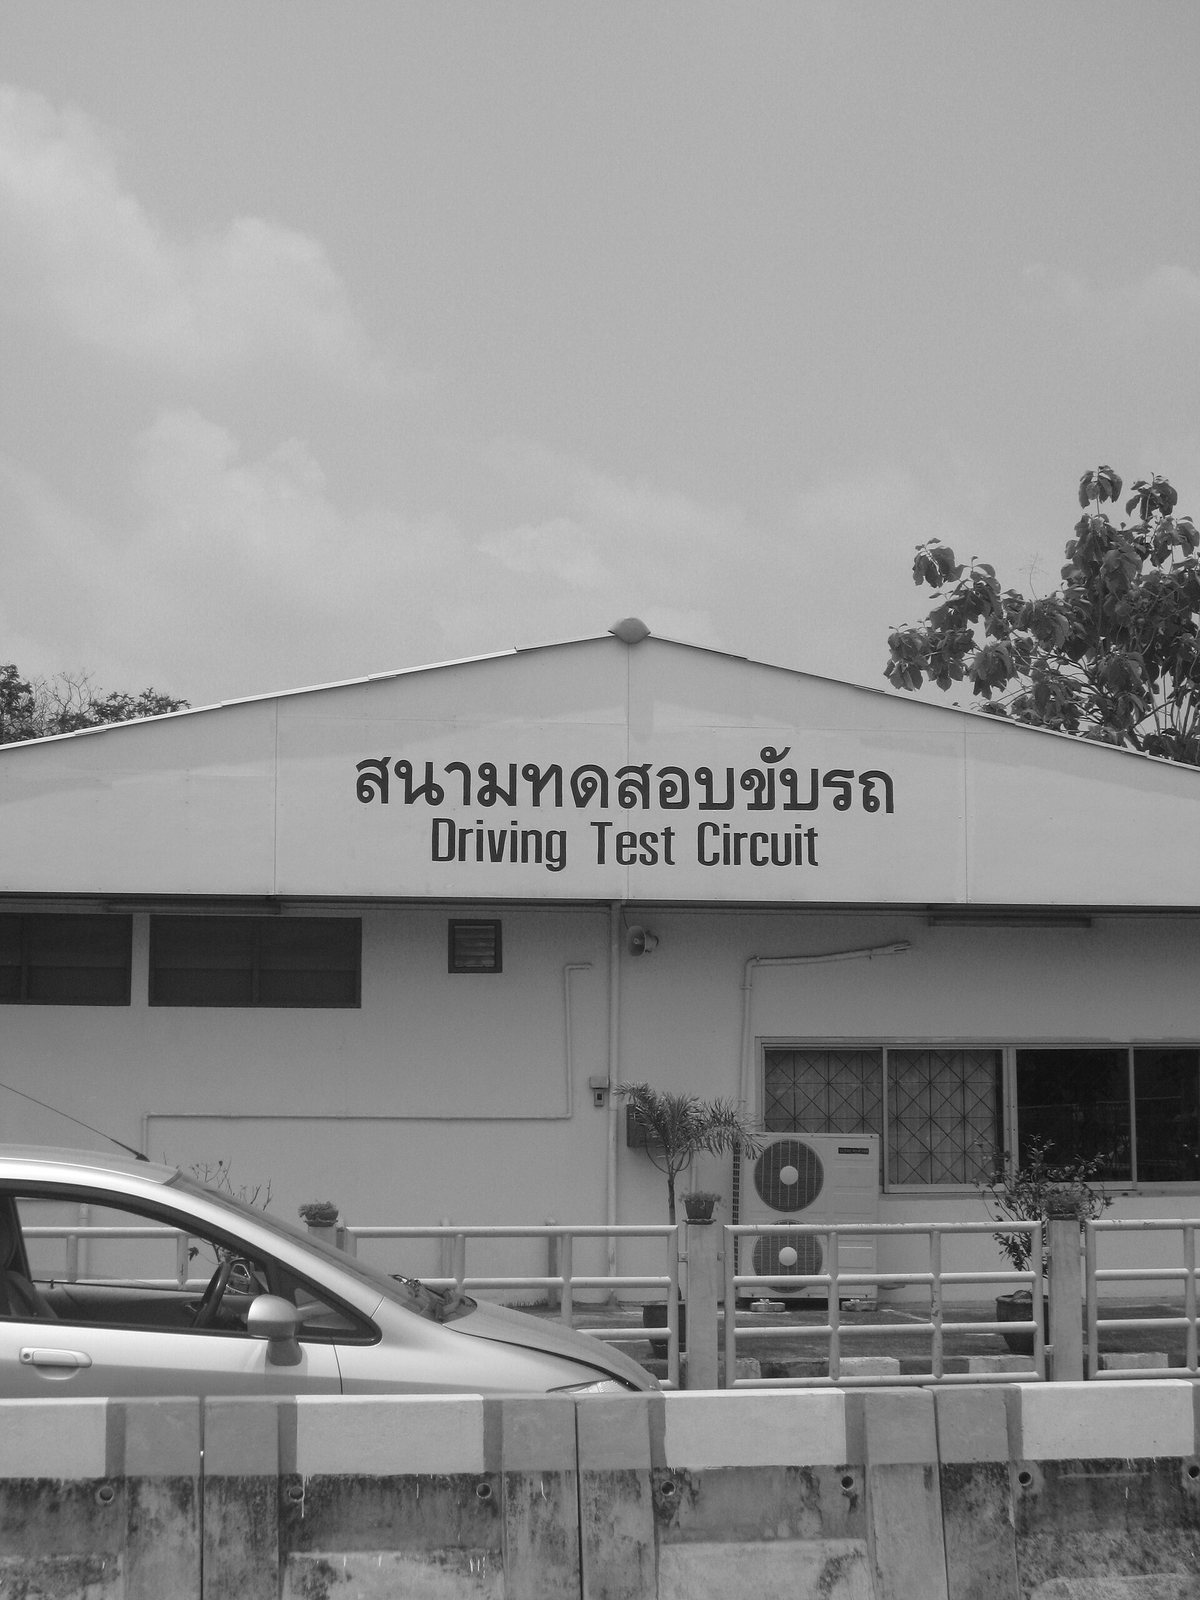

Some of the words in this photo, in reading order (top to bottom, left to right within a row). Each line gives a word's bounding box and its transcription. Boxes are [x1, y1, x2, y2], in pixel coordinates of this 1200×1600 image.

[356, 747, 894, 813] สนามทดสอบขับรถ
[432, 818, 567, 872] Driving
[591, 822, 676, 866] Test
[698, 822, 819, 867] Circuit
